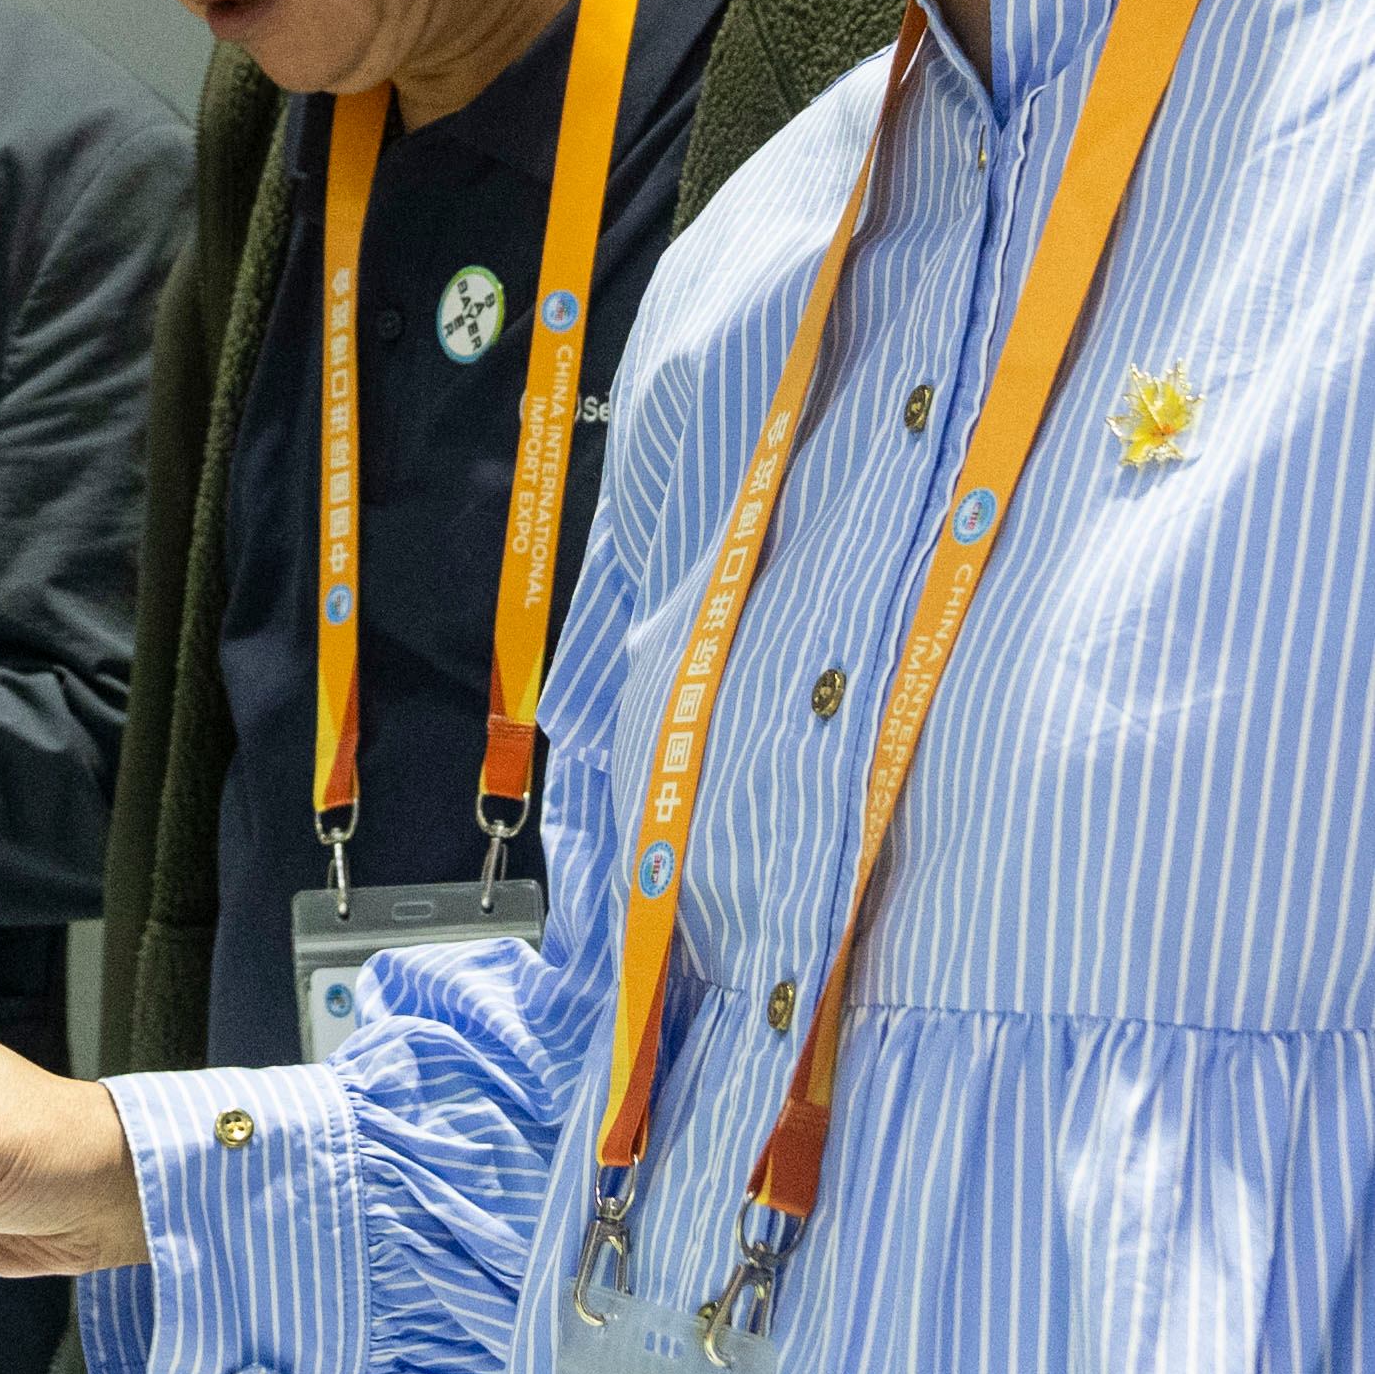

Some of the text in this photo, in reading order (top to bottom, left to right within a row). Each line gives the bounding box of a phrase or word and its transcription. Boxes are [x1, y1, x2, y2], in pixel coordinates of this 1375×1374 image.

[443, 292, 495, 338] BAYER
[457, 279, 483, 352] BAYER
[512, 396, 547, 555] IMPORT EXPO
[523, 344, 574, 610] CHINA INTERNATIONAL
[583, 395, 610, 423] Se
[655, 409, 791, 823] 中国国际进口博览会
[869, 563, 973, 847] CHINA INTERNA
[881, 635, 929, 757] IMPORT
